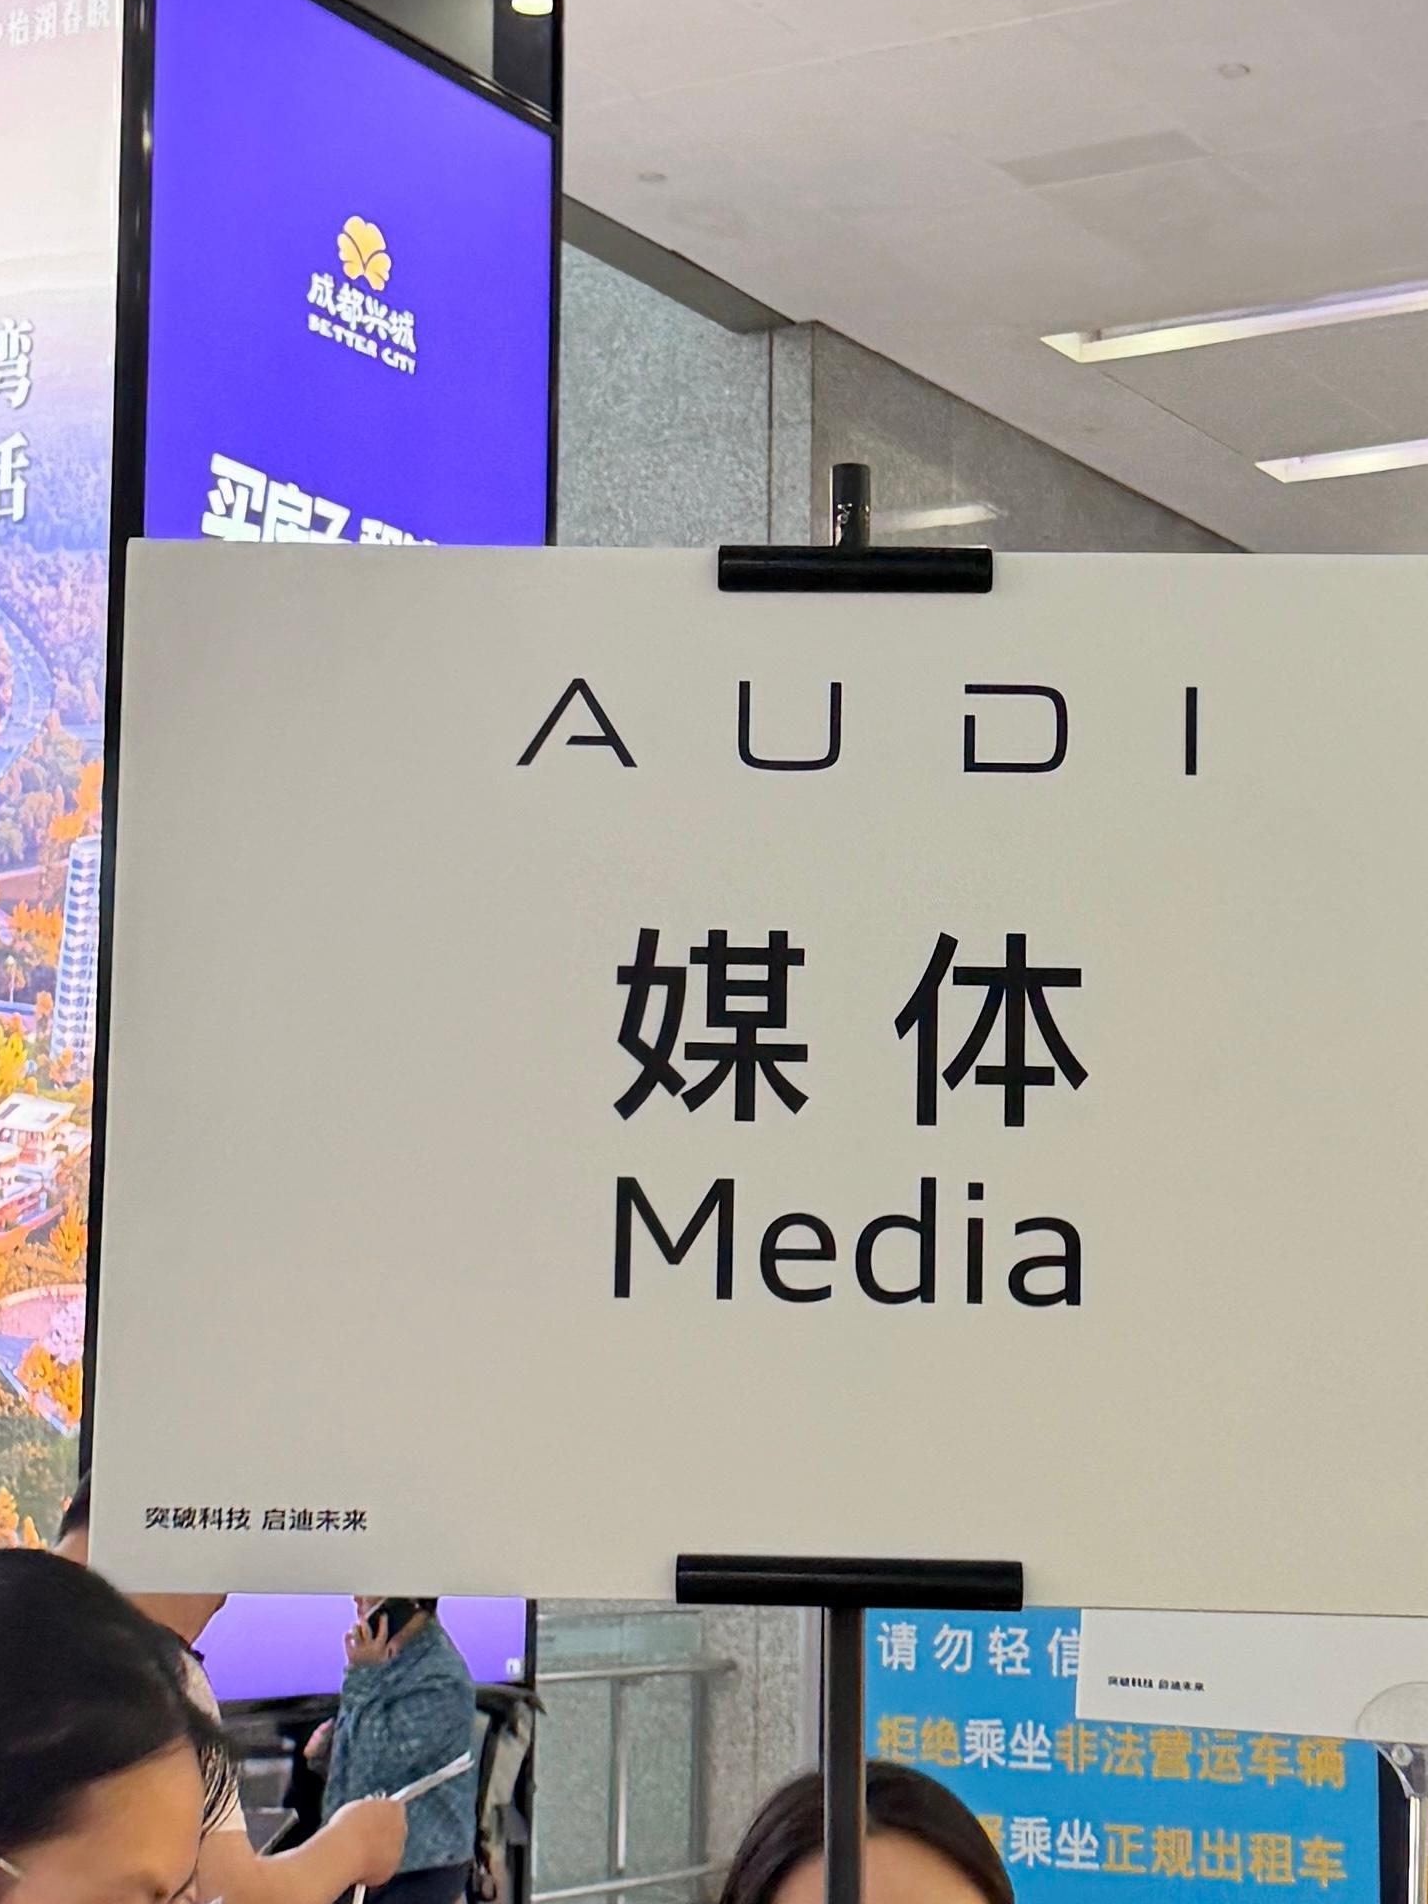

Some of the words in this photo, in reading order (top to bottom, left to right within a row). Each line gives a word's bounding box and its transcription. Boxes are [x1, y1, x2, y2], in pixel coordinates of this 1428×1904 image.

[307, 273, 416, 353] 成都兴城
[308, 313, 377, 358] BETTER
[381, 347, 416, 375] CITY
[517, 678, 1200, 776] AUDI
[613, 927, 1088, 1127] 媒体
[614, 1177, 1083, 1307] Media
[144, 1506, 251, 1530] 突破科技
[261, 1507, 368, 1532] 启迪未来
[876, 1621, 1081, 1678] 请勿轻信
[876, 1714, 1347, 1789] 拒绝乘坐非法营运车辆
